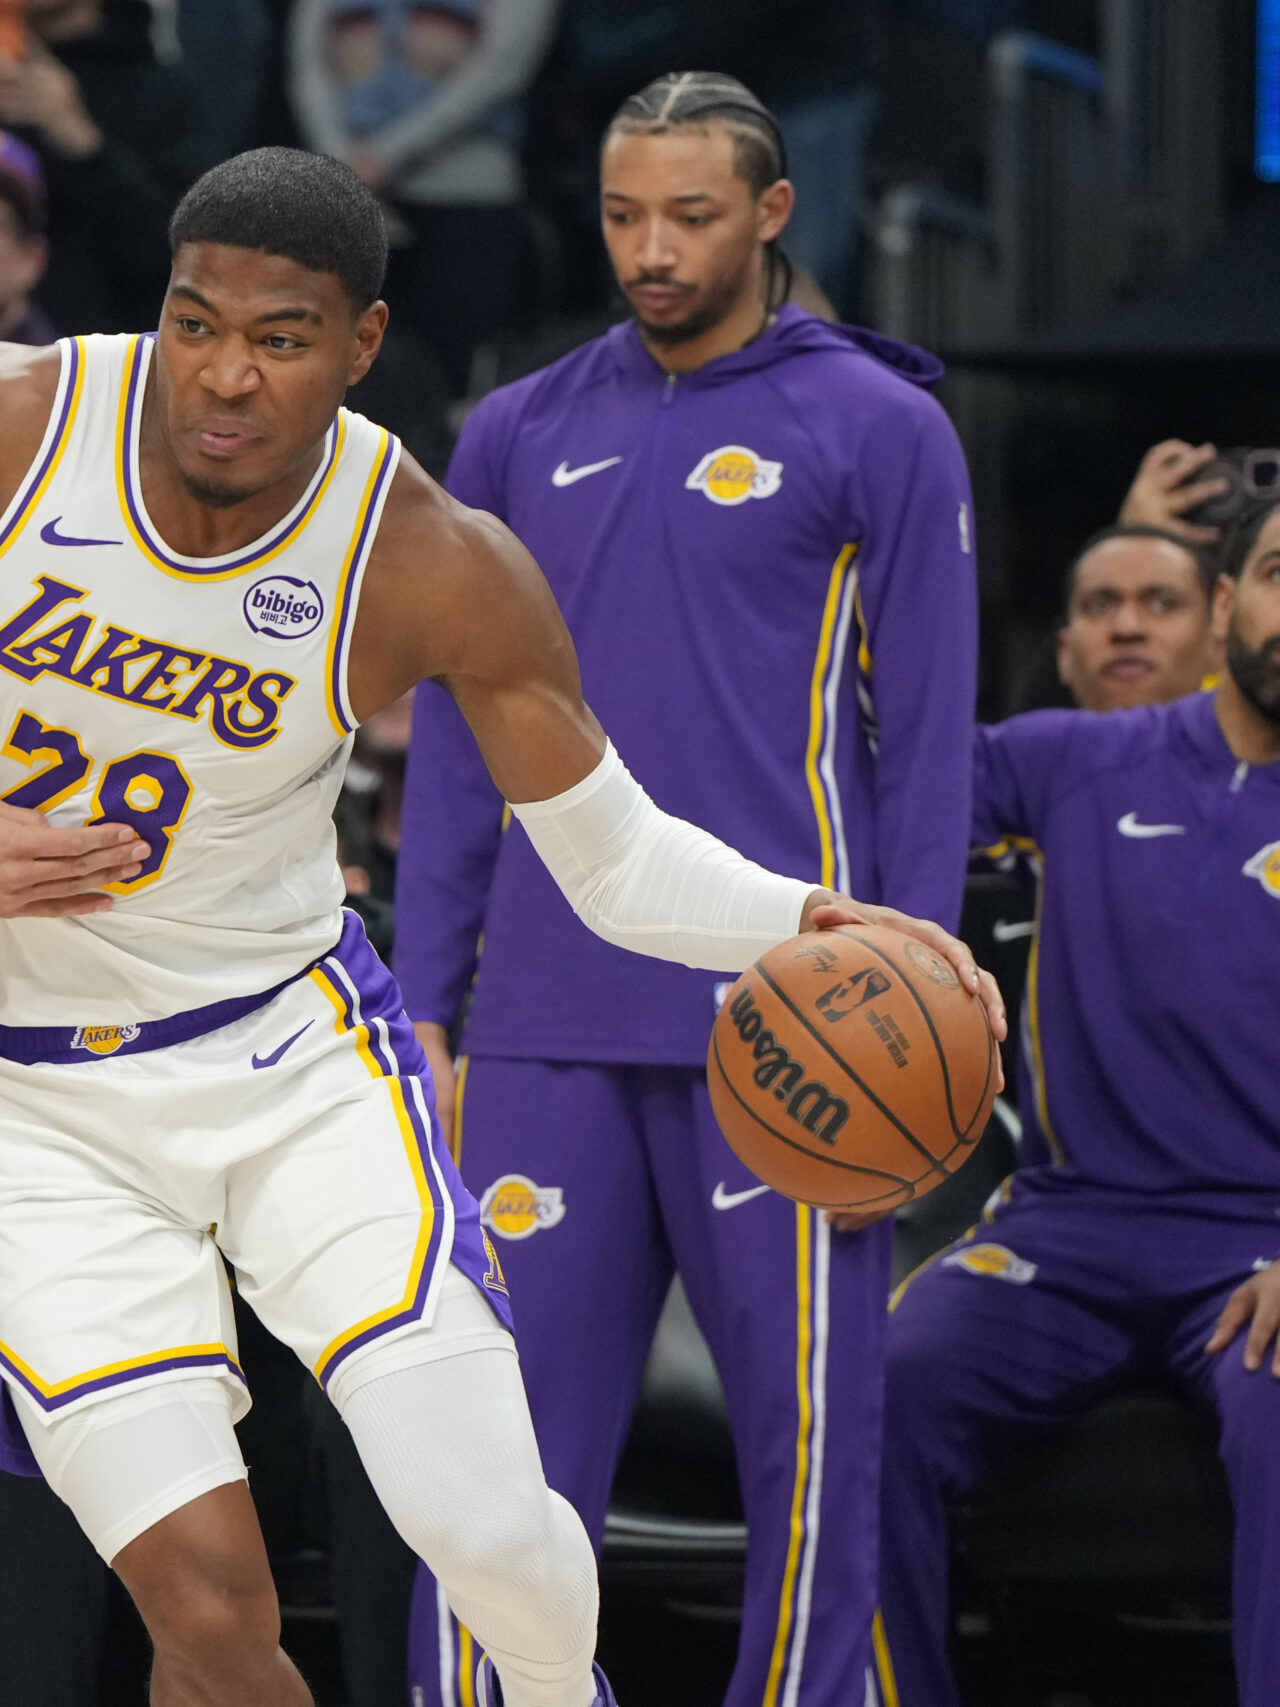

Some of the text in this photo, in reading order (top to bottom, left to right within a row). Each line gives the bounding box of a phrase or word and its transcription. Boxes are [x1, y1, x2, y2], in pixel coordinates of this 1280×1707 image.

[252, 588, 318, 624] bibigo
[260, 610, 288, 625] 비비고
[729, 984, 850, 1146] Wilson
